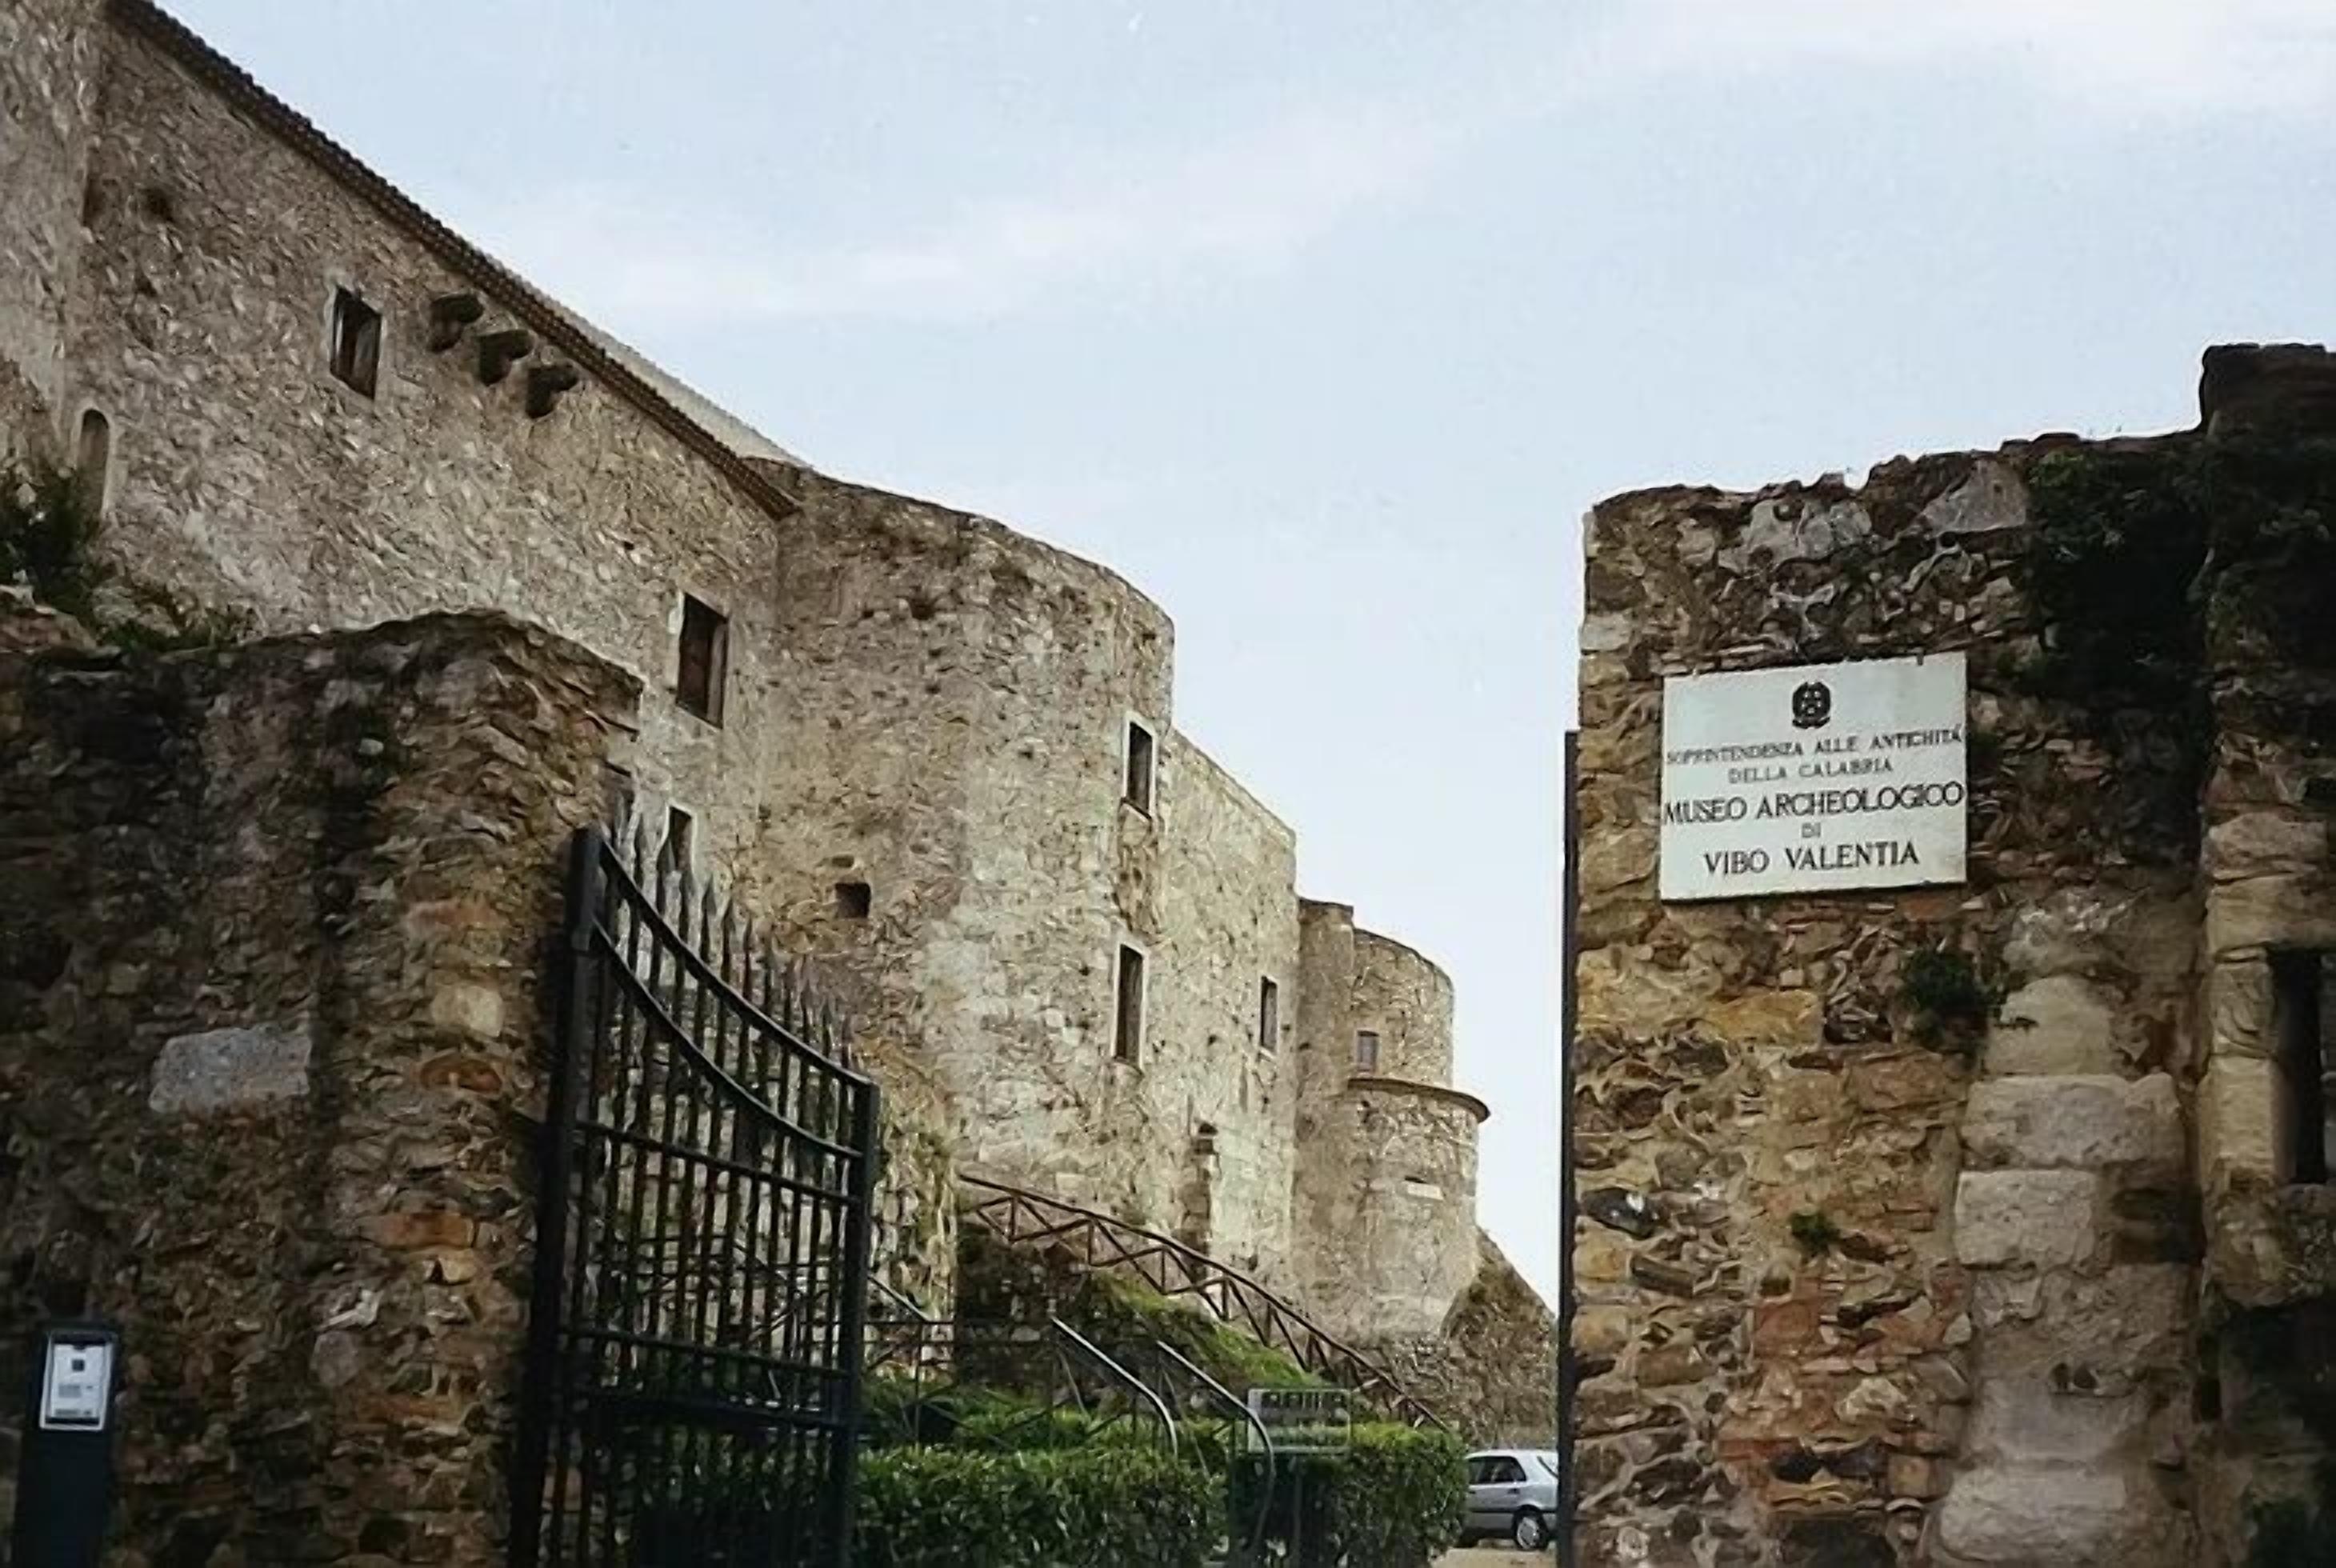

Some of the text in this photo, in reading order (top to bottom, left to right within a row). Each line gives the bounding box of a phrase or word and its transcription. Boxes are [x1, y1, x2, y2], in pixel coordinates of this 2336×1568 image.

[1815, 735, 1856, 753] ALLE
[1728, 758, 1893, 784] DELLA CALABRIA
[1663, 781, 1964, 825] MUSEO ARCHEOLOGICO
[1802, 822, 1821, 838] DI
[1703, 840, 1920, 874] VIBO VALENTIA
